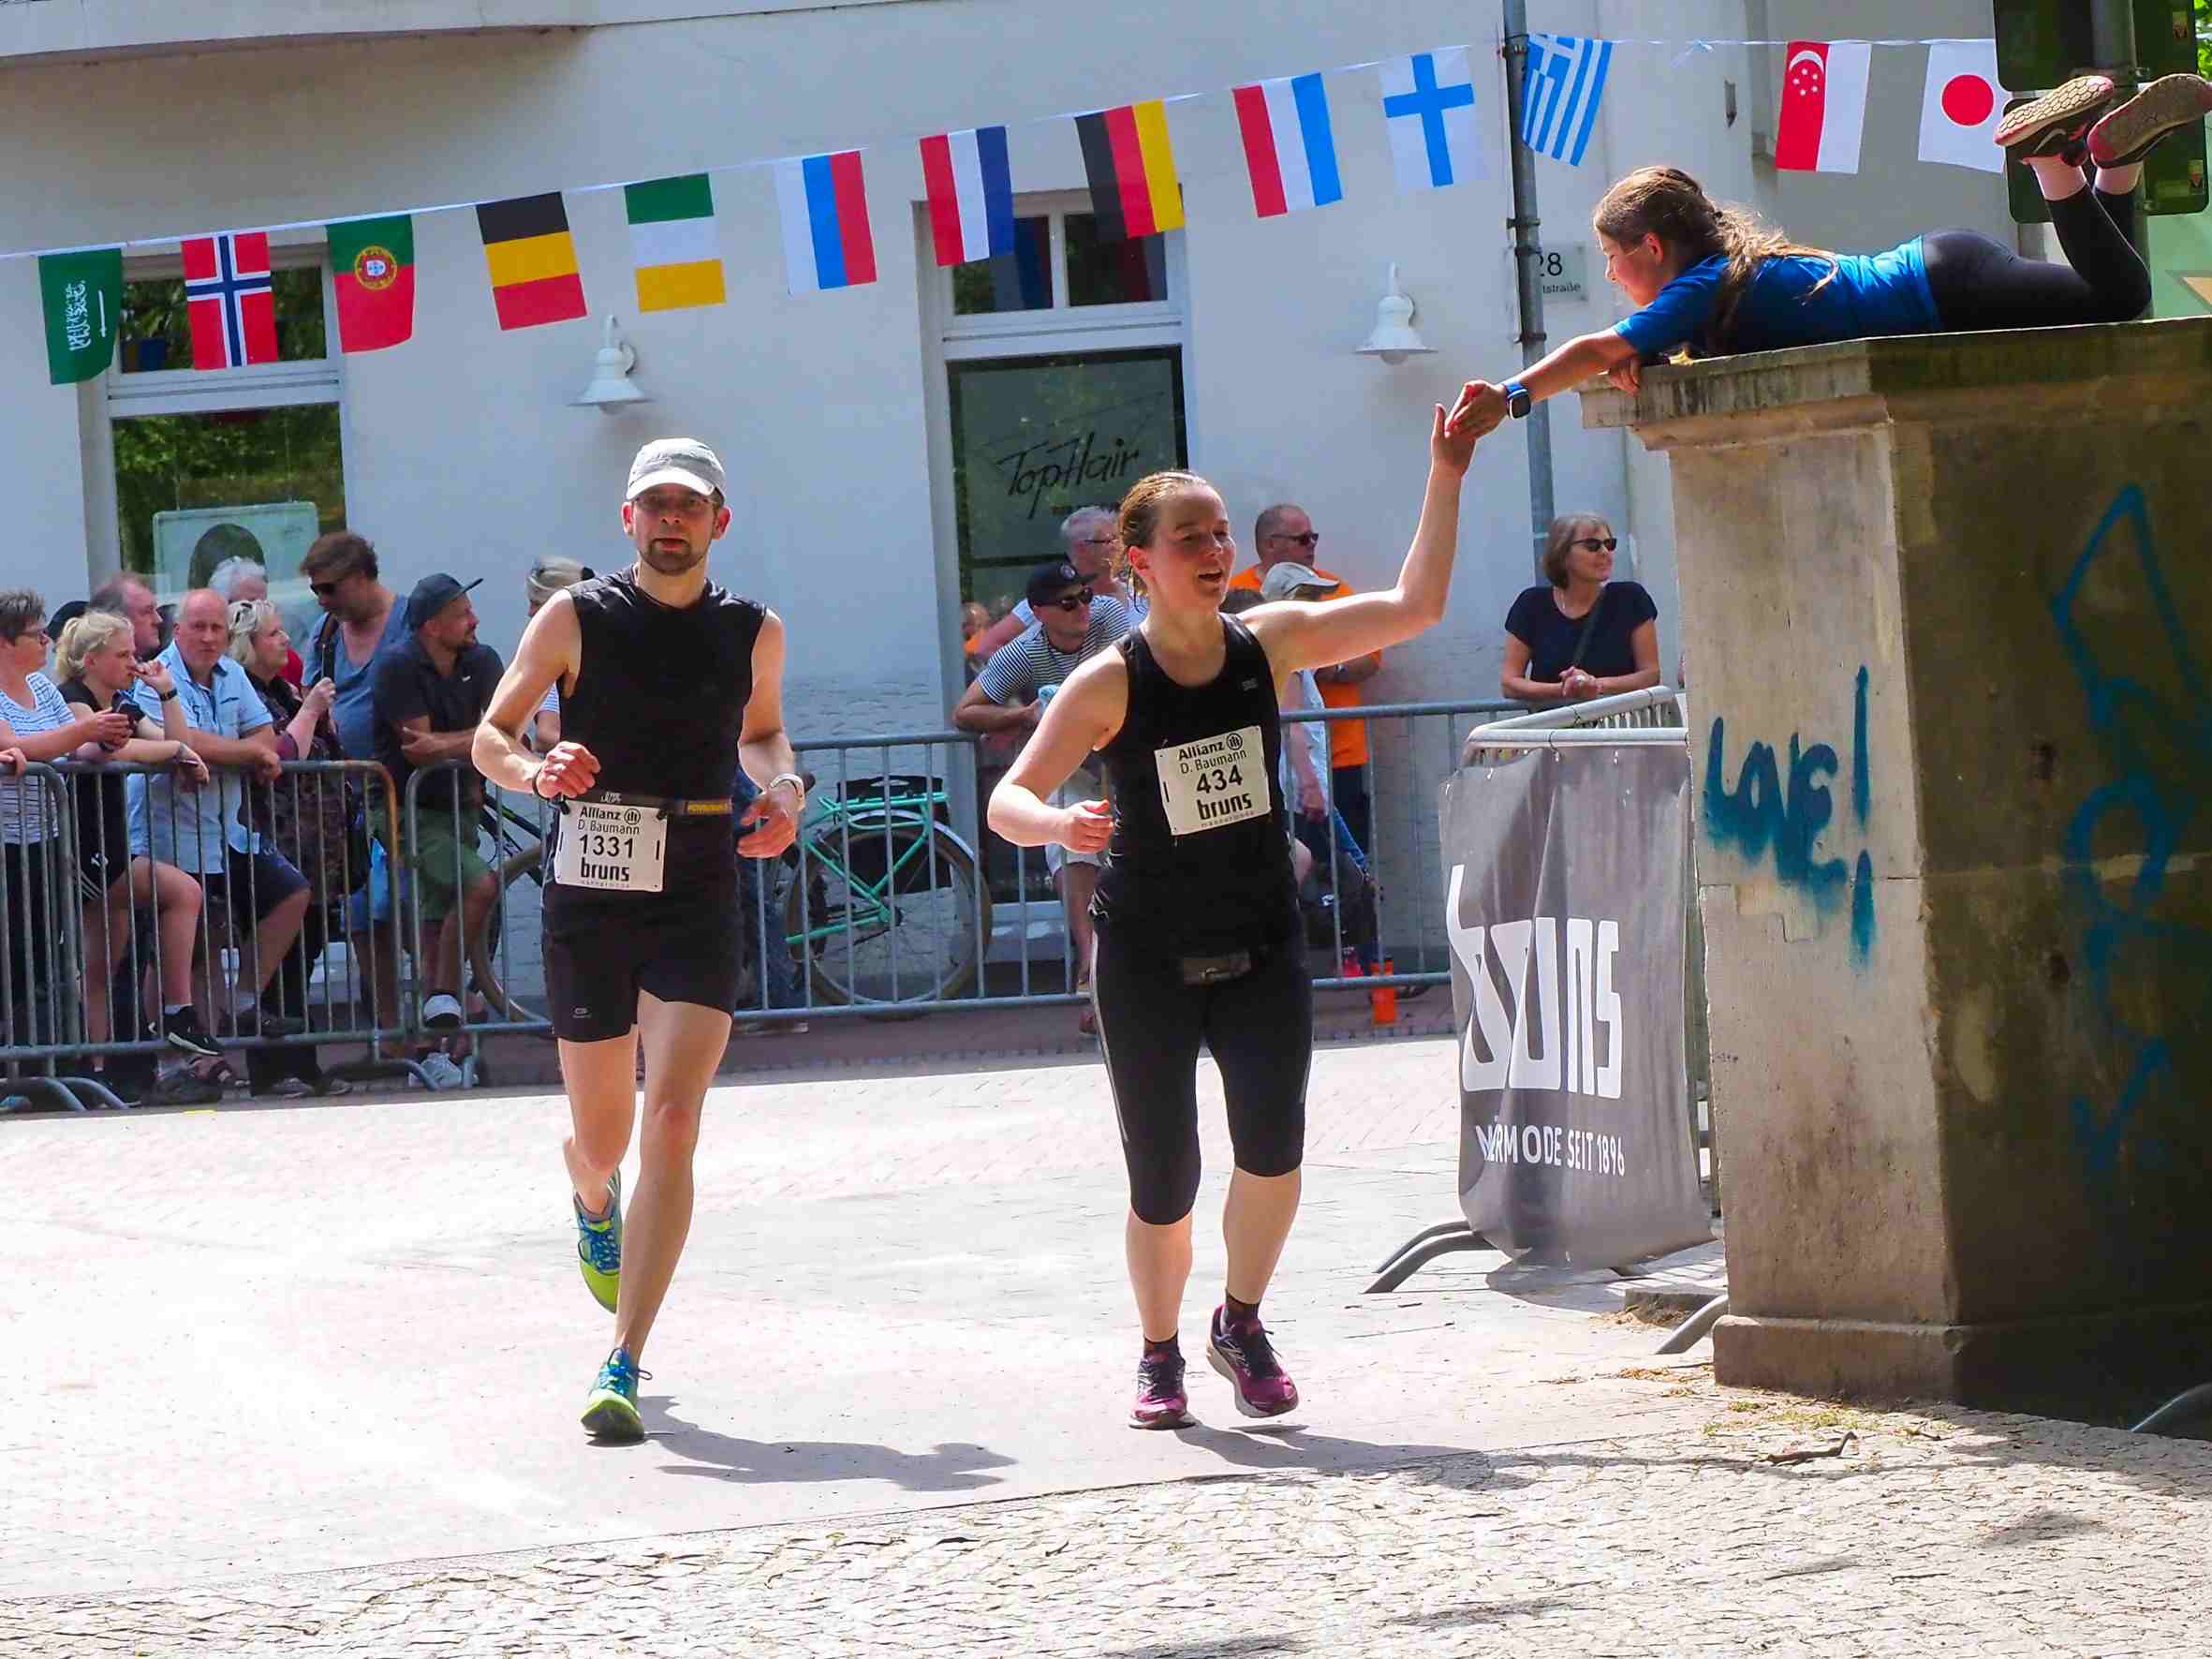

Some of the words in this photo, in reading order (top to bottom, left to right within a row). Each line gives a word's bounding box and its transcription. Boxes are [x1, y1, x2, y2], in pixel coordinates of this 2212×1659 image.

[1178, 741, 1225, 762] Allianz
[1180, 763, 1193, 774] D.
[1195, 749, 1247, 771] Baumann
[1196, 764, 1243, 793] 434
[580, 807, 621, 821] Allianz
[1197, 793, 1253, 821] bruns
[590, 820, 641, 836] Baumann
[579, 834, 634, 859] 1331
[581, 857, 630, 881] bruns
[1567, 1129, 1593, 1172] SEIT
[1597, 1133, 1626, 1178] 1896
